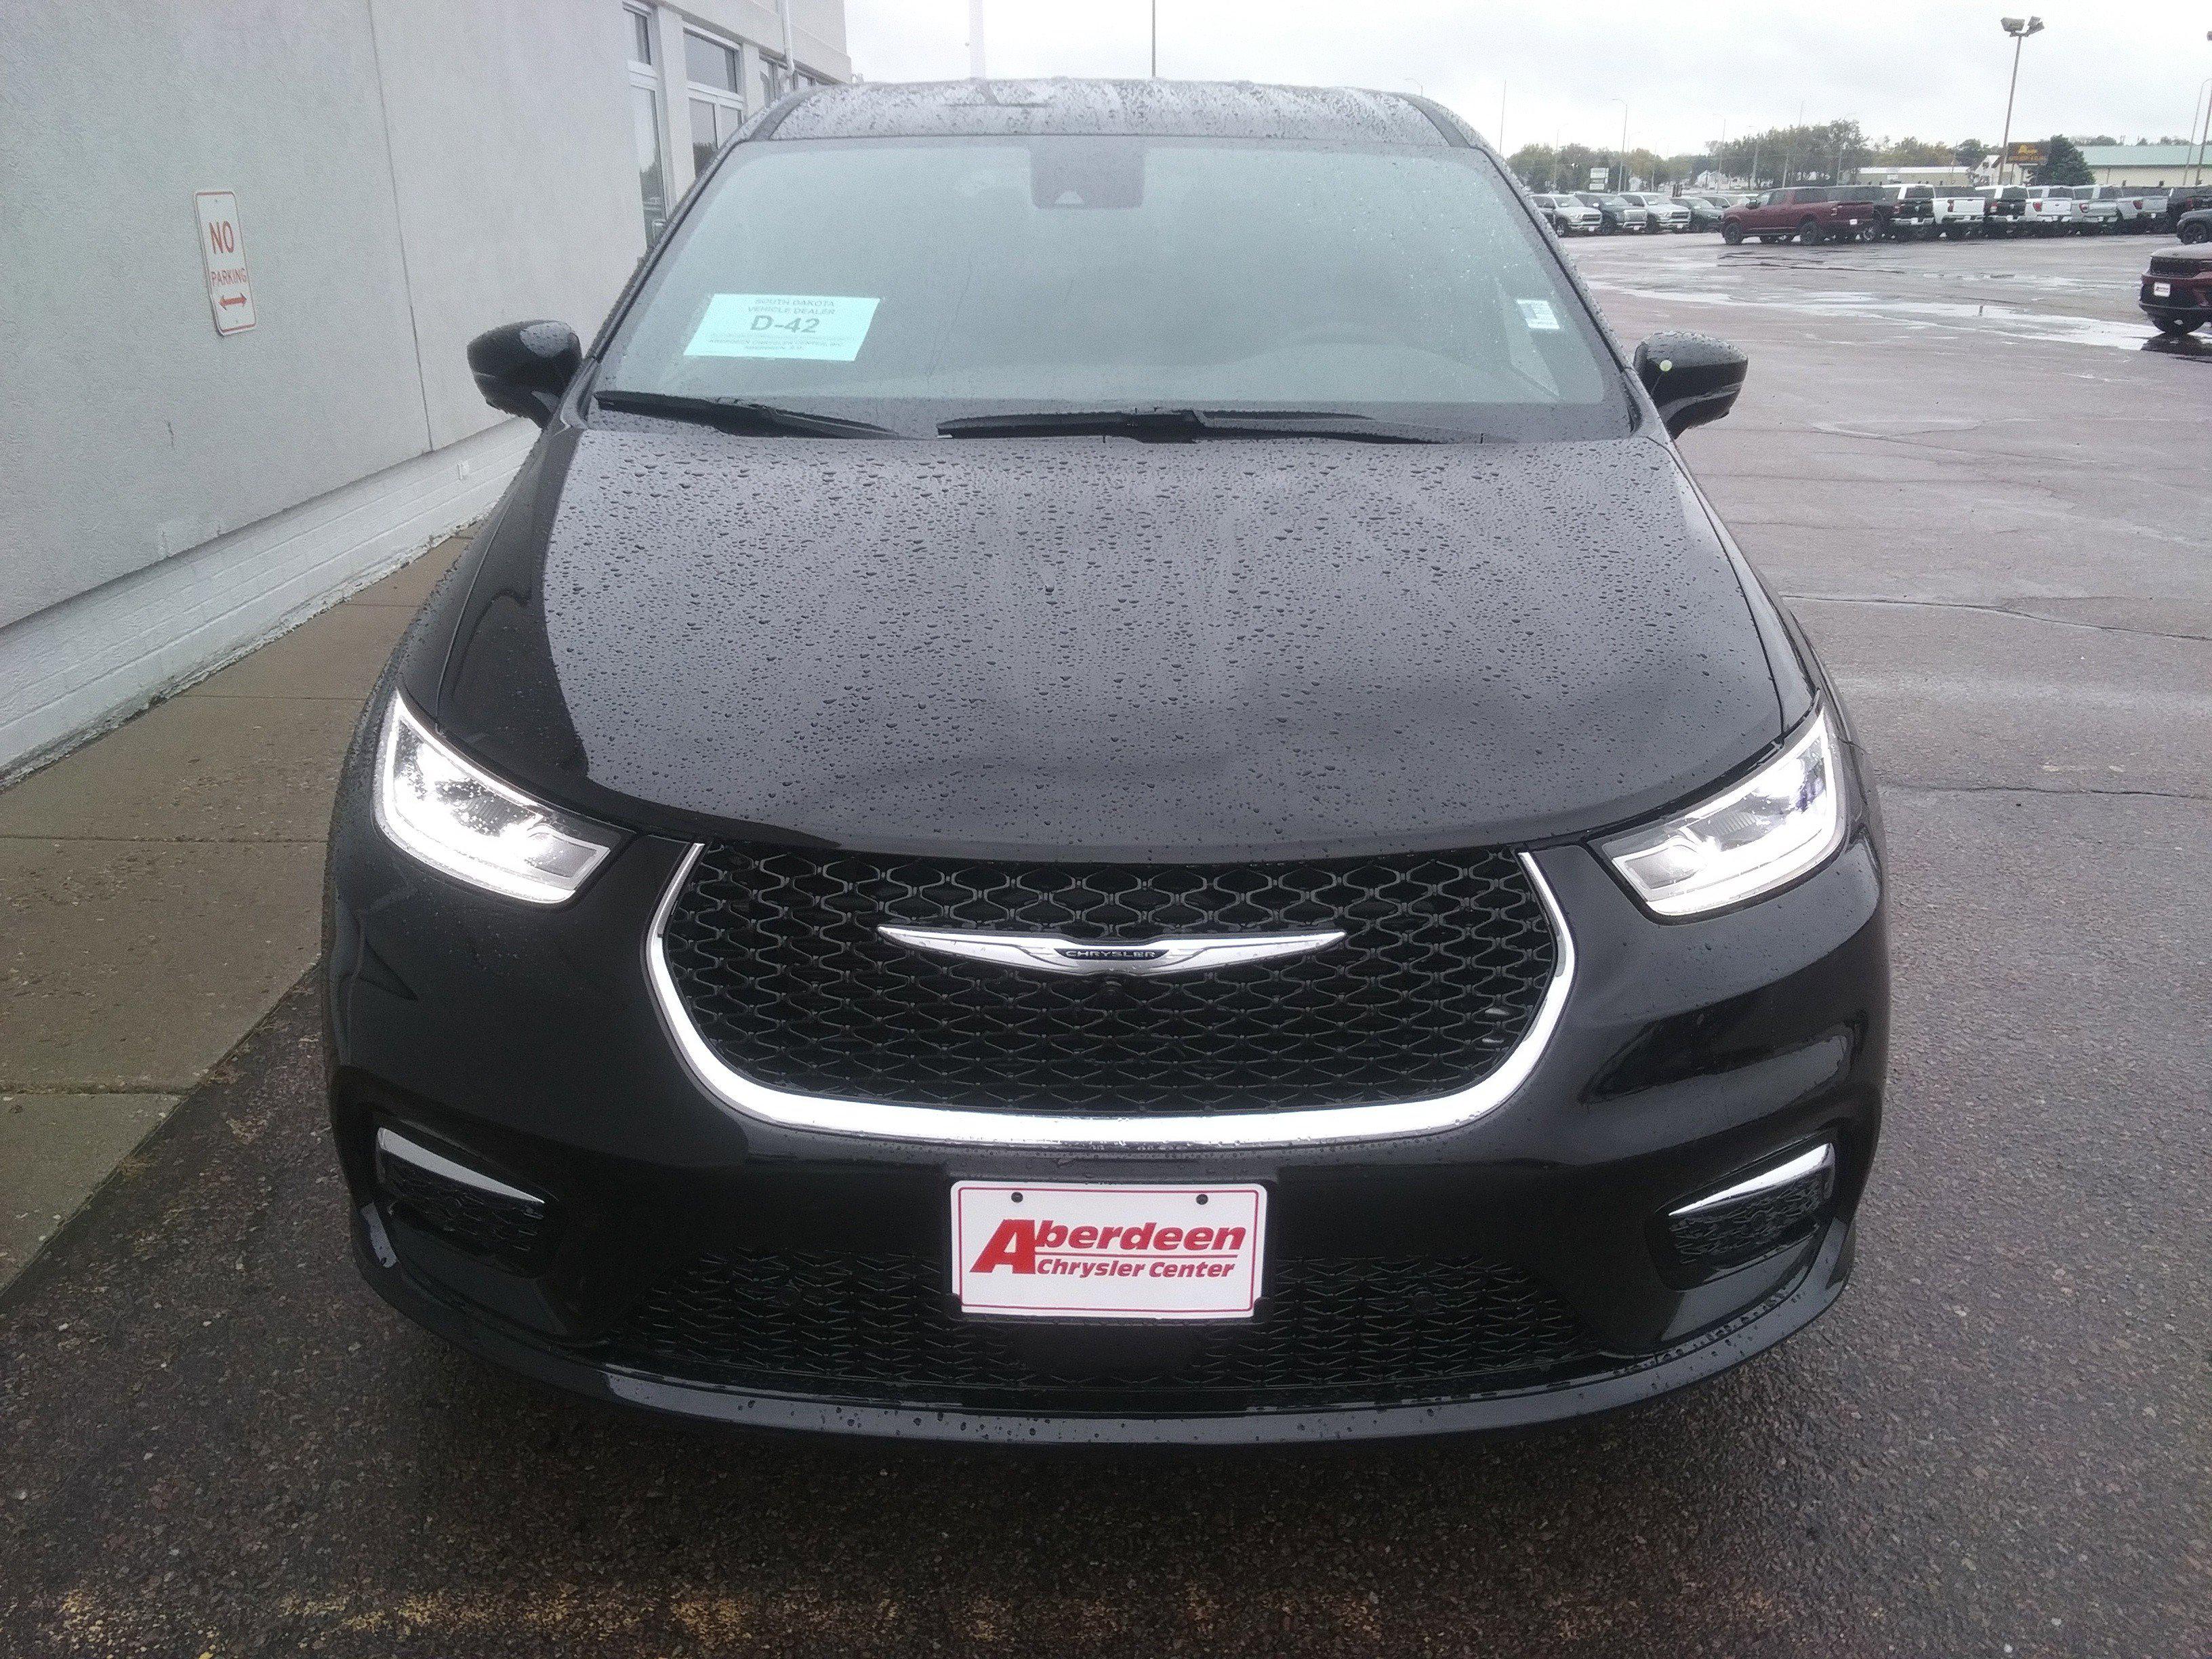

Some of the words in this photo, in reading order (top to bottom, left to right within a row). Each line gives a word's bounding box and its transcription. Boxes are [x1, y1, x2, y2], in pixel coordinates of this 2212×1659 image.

[209, 220, 234, 254] NO
[211, 268, 247, 286] PARKING
[747, 306, 792, 314] VEHICLE
[755, 298, 790, 306] SOUTH
[792, 300, 835, 308] DAKOTA
[750, 314, 820, 333] D-42
[969, 1219, 1246, 1275] Aberdeen
[1036, 1258, 1147, 1278] Chrysler
[1149, 1262, 1235, 1278] Center
